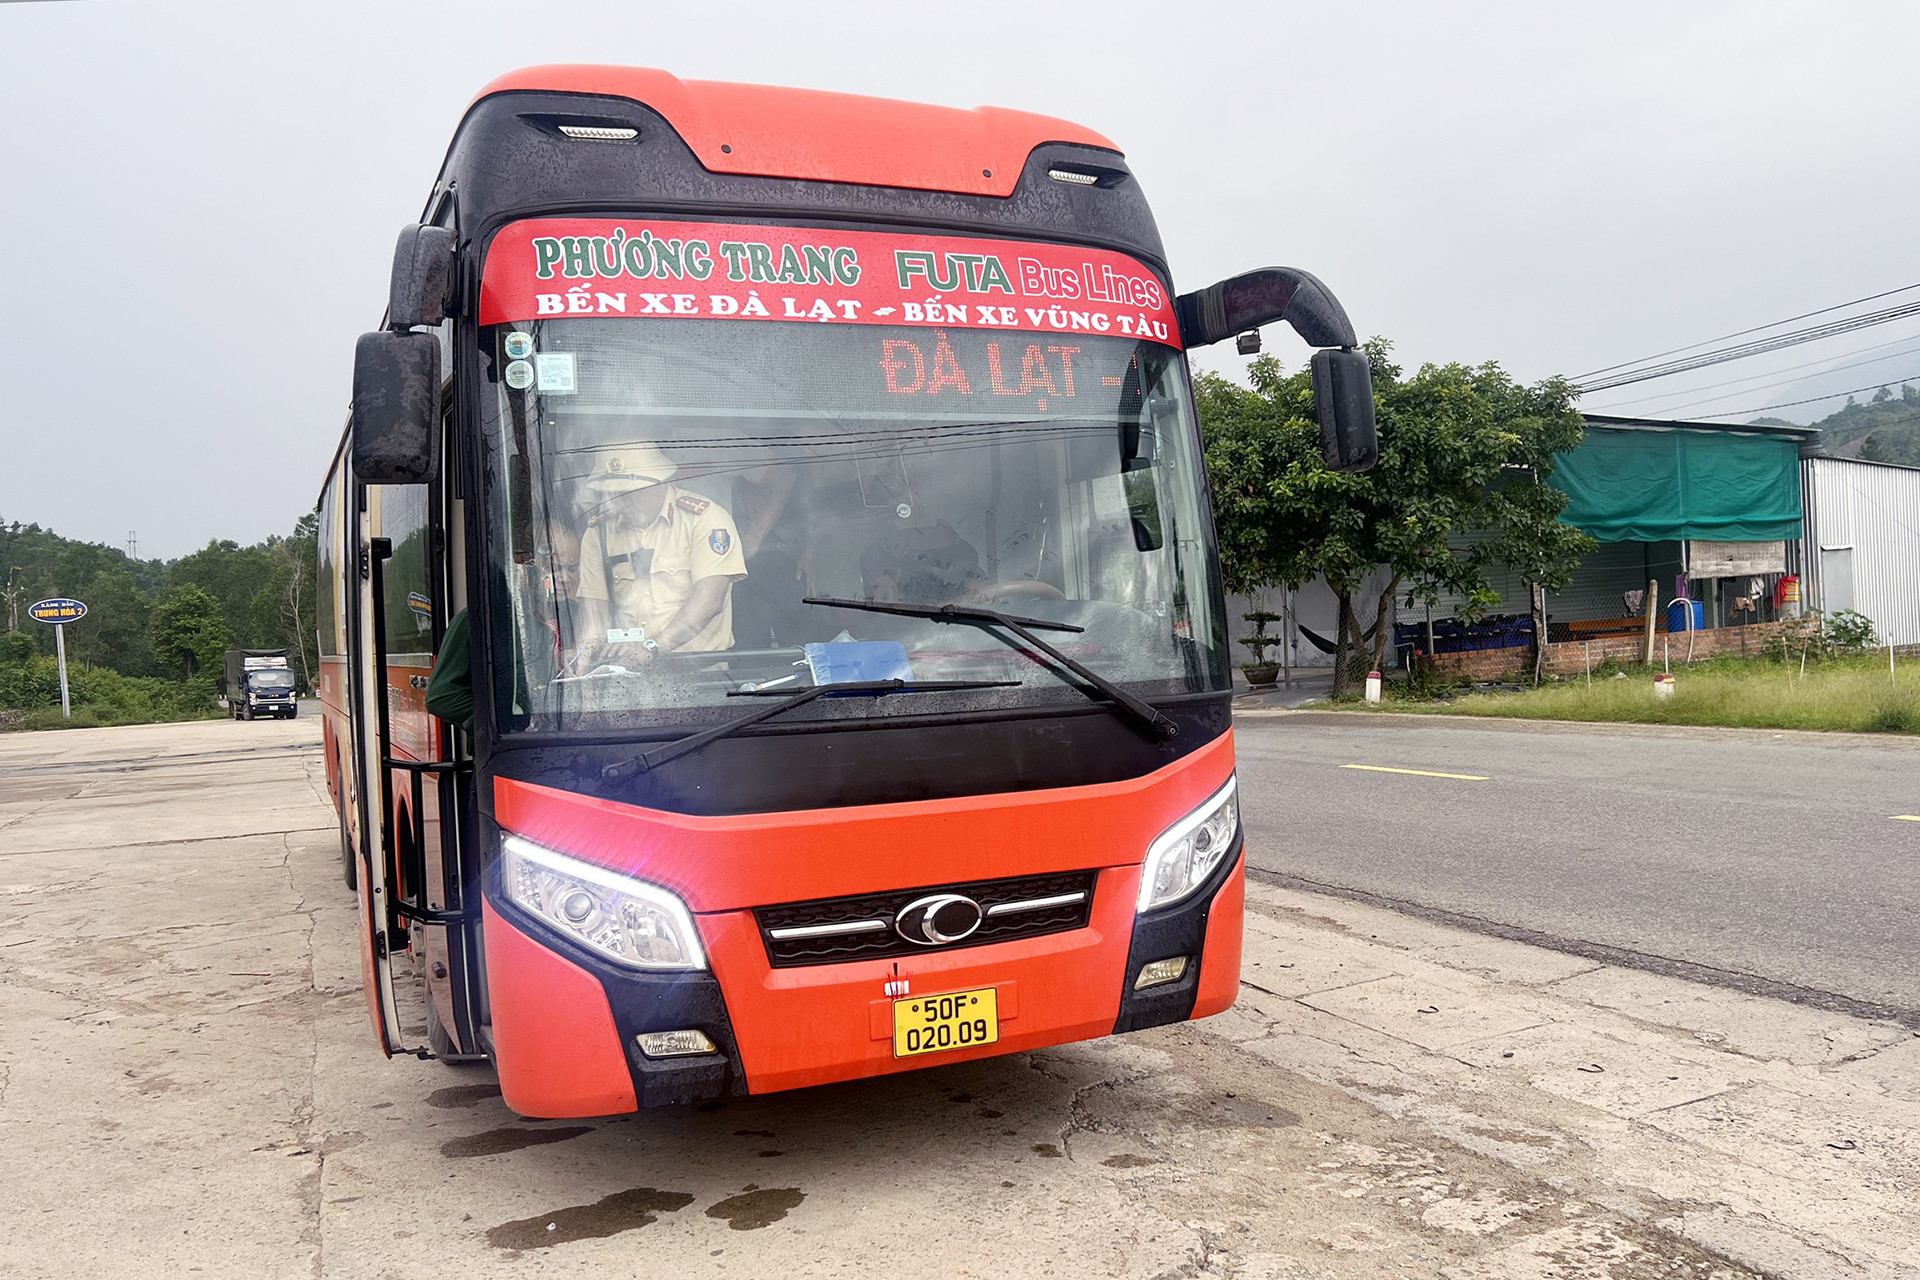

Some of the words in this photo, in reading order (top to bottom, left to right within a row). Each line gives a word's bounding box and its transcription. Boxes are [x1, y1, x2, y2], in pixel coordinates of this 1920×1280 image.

[532, 227, 714, 280] PHƯƠNG
[721, 241, 862, 286] TRANG
[894, 249, 1016, 295] FUTA
[1018, 257, 1081, 299] Bus
[1083, 262, 1162, 310] Lines
[536, 283, 627, 315] BẾN
[639, 293, 699, 315] XE
[709, 290, 771, 316] ĐÀ
[781, 298, 862, 322] LẠT
[902, 294, 968, 323] BẾN
[976, 305, 1019, 326] XE
[1024, 304, 1111, 331] VŨNG
[1117, 313, 1169, 340] TÀU
[879, 327, 973, 395] ĐÀ
[986, 343, 1082, 411] LẠT
[34, 609, 59, 618] TRUNG
[60, 607, 76, 617] HÒA
[77, 607, 83, 616] 2
[924, 995, 968, 1023] 50F
[907, 1019, 987, 1051] 020.09
